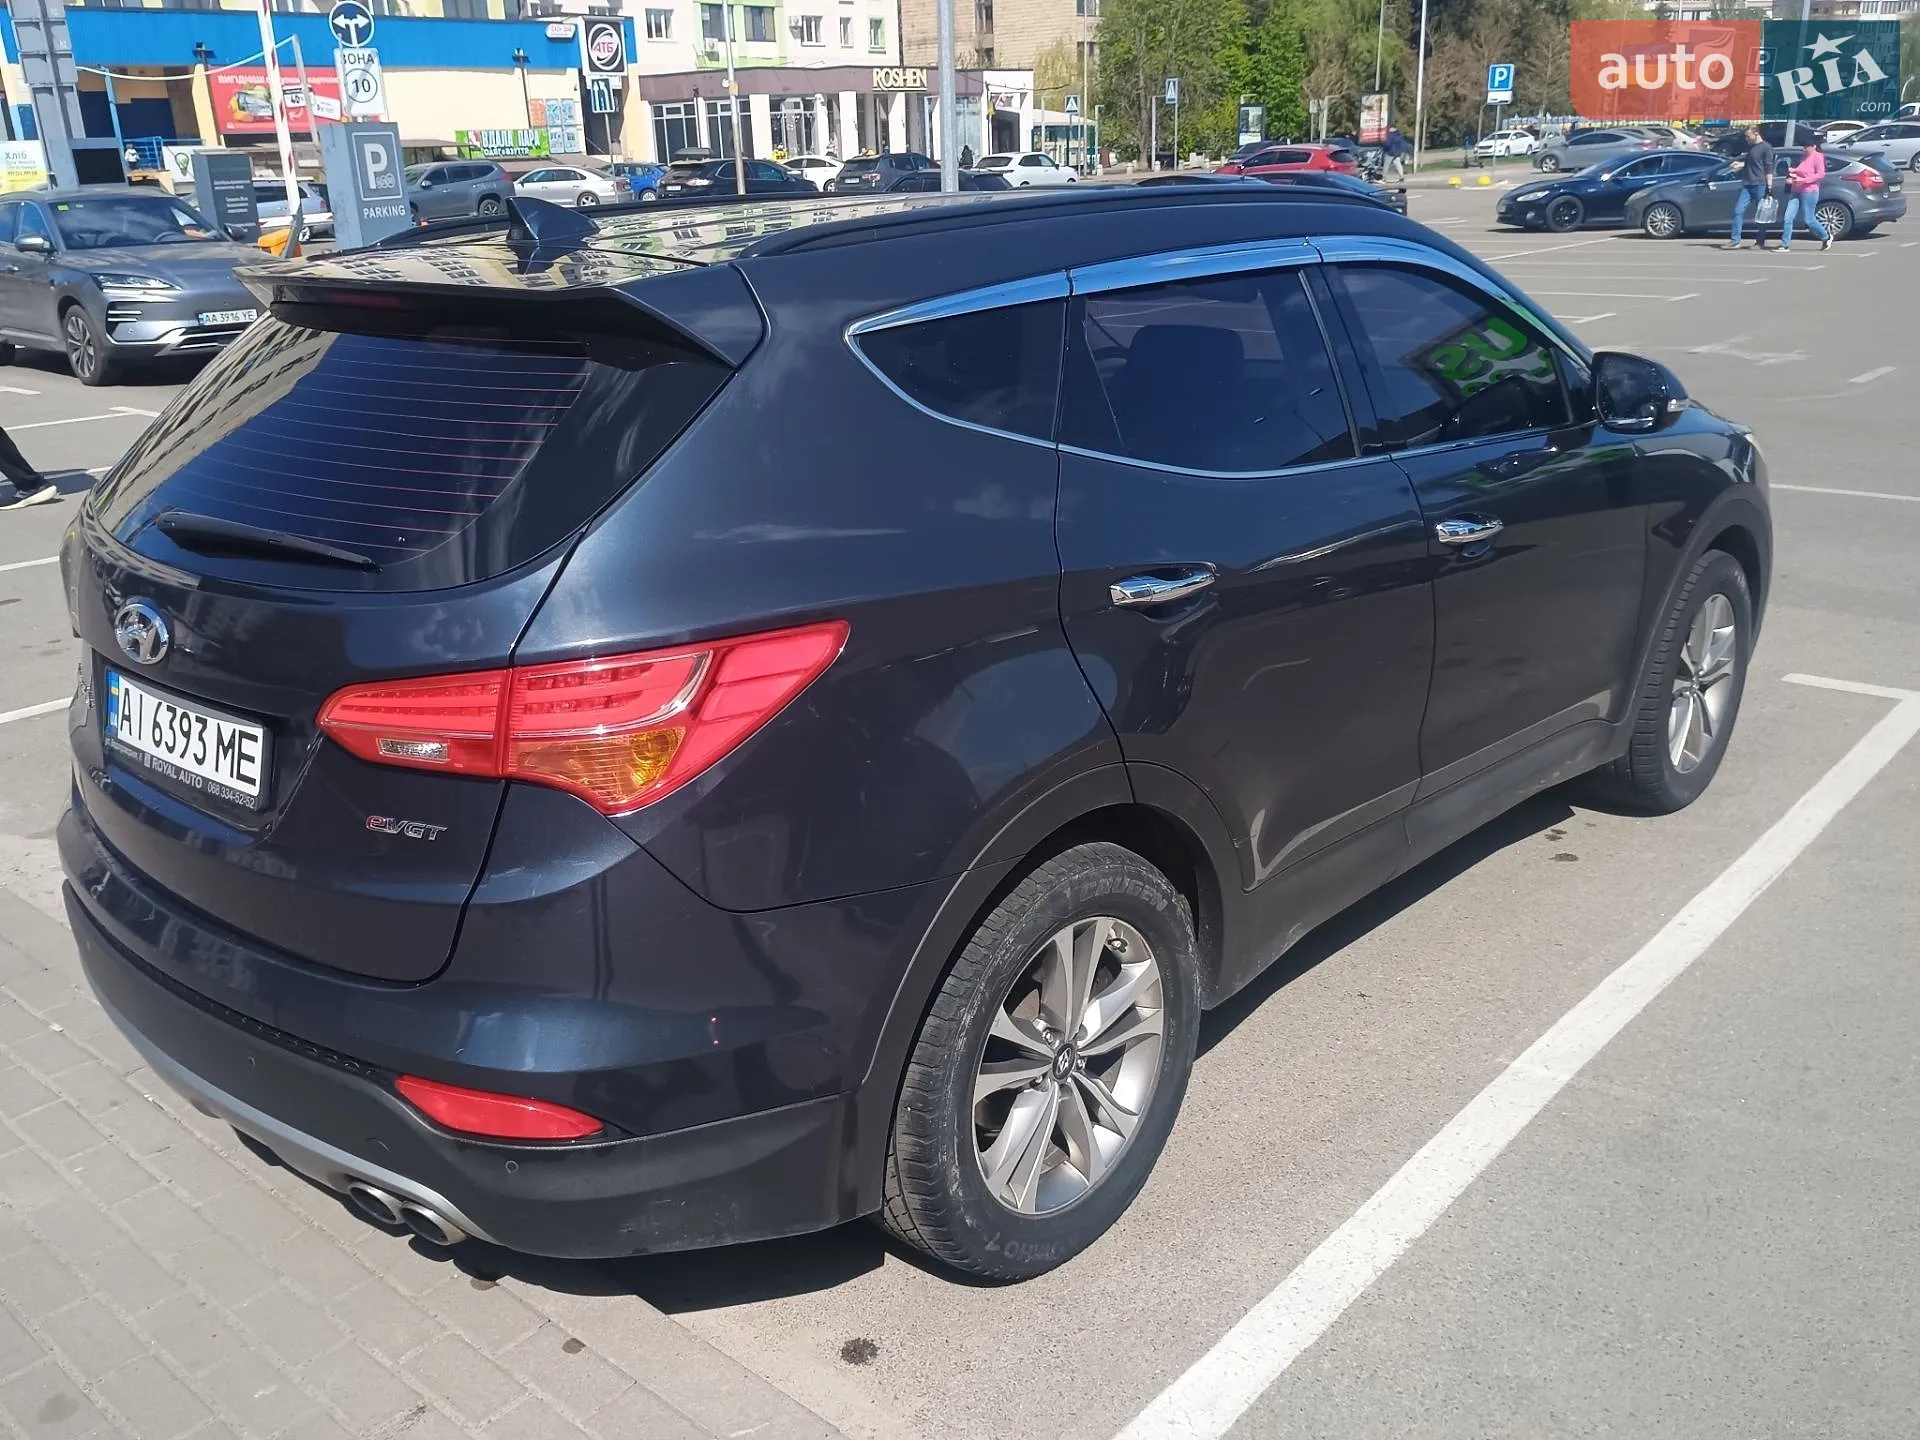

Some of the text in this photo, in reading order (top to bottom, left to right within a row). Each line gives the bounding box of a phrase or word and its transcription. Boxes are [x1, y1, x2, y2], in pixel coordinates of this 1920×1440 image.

[592, 40, 615, 54] АТБ
[342, 53, 375, 65] ЗОНА
[872, 68, 928, 90] ROSHEN
[1493, 67, 1508, 87] P
[351, 78, 372, 94] 10
[518, 129, 541, 147] ПАРА
[5, 151, 28, 160] Хліб
[363, 204, 406, 219] PARKING
[205, 314, 217, 323] AA
[119, 687, 143, 741] AI
[151, 701, 207, 766] 6393
[215, 722, 260, 787] ME
[152, 758, 203, 788] ROYAL AUTO
